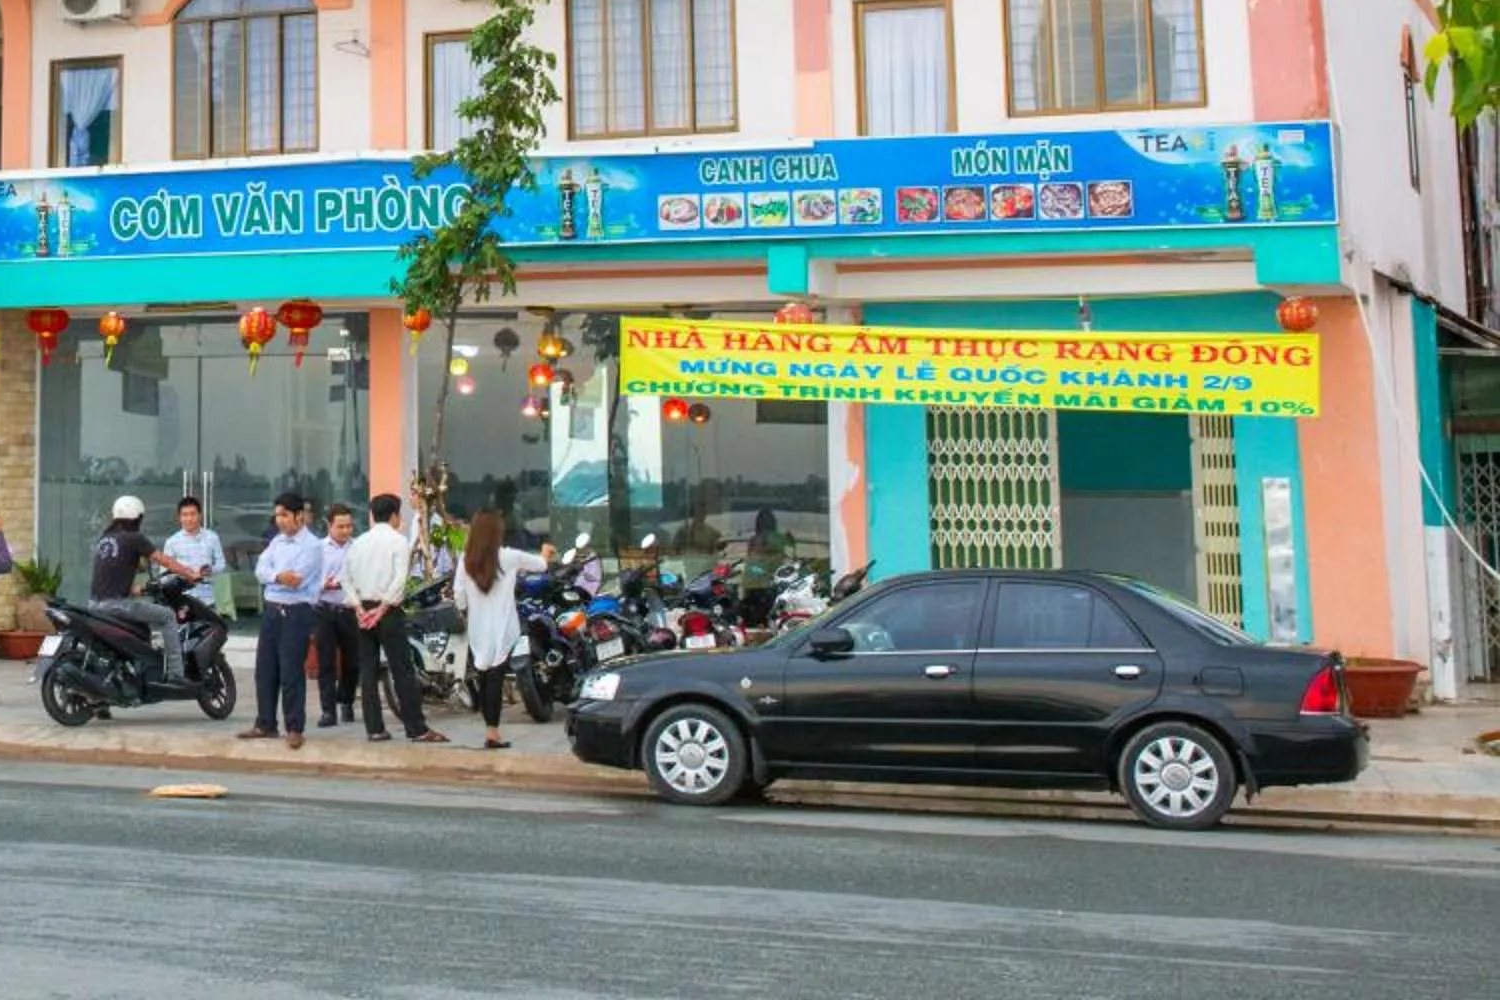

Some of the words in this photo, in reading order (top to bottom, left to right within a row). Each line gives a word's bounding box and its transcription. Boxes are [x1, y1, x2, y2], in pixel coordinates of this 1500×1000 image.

[699, 156, 767, 184] CANH
[770, 152, 839, 183] CHUA
[952, 140, 1009, 176] MÓN
[110, 188, 203, 241] CƠM
[212, 182, 303, 237] VĂN
[627, 325, 706, 349] NHÀ
[723, 329, 832, 353] HÀNG
[925, 337, 1039, 363] THỰC
[1055, 341, 1175, 366] RẠNG
[1190, 339, 1314, 366] ĐÔNG
[950, 363, 1047, 384] QUỐC
[1203, 375, 1253, 392] 2/9
[627, 379, 766, 397] CHƯƠNG
[1241, 400, 1316, 416] 10%
